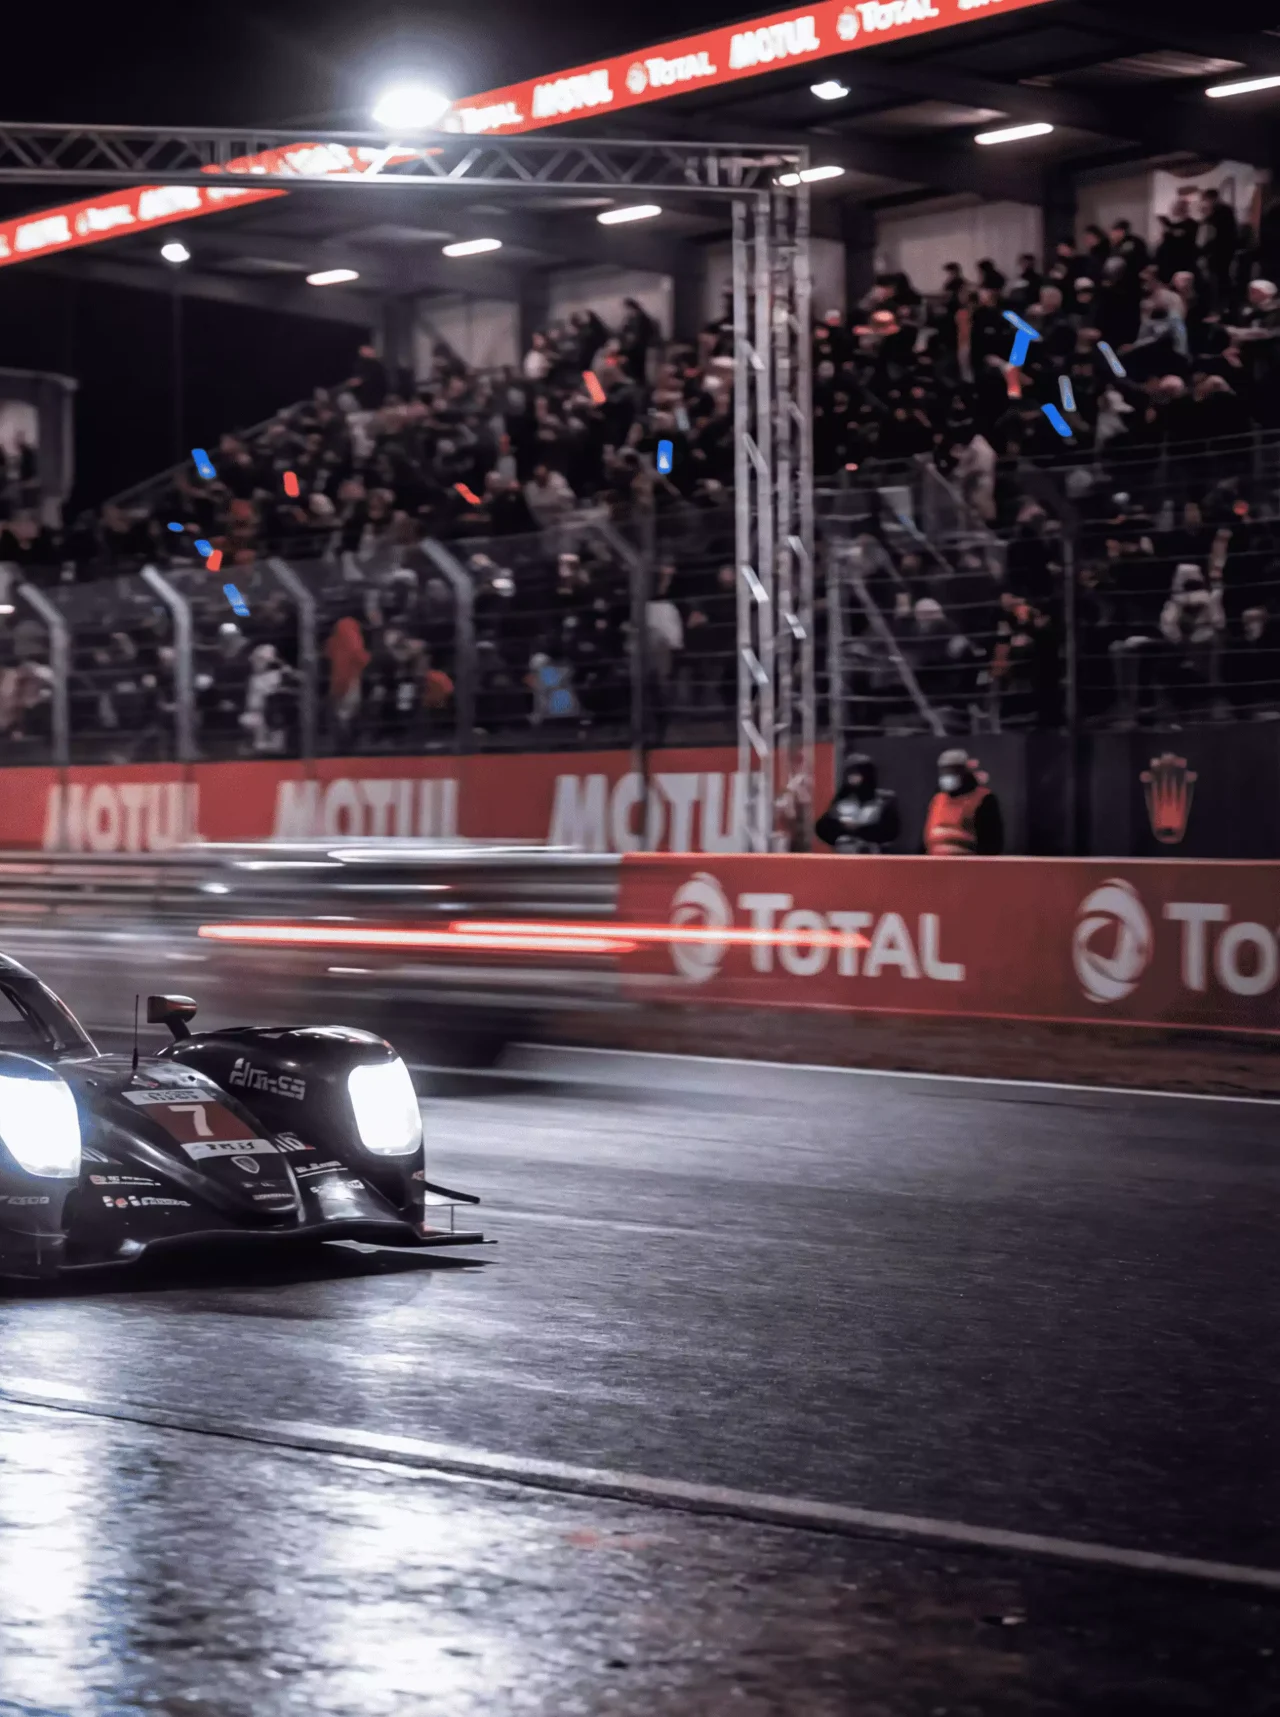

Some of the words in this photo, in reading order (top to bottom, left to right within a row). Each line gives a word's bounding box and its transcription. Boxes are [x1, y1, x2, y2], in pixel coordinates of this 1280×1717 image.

[729, 16, 819, 69] MOTUL
[42, 782, 208, 851] MOTUL
[737, 893, 965, 981] TOTAL
[1162, 902, 1280, 996] TO
[168, 1104, 214, 1136] 7
